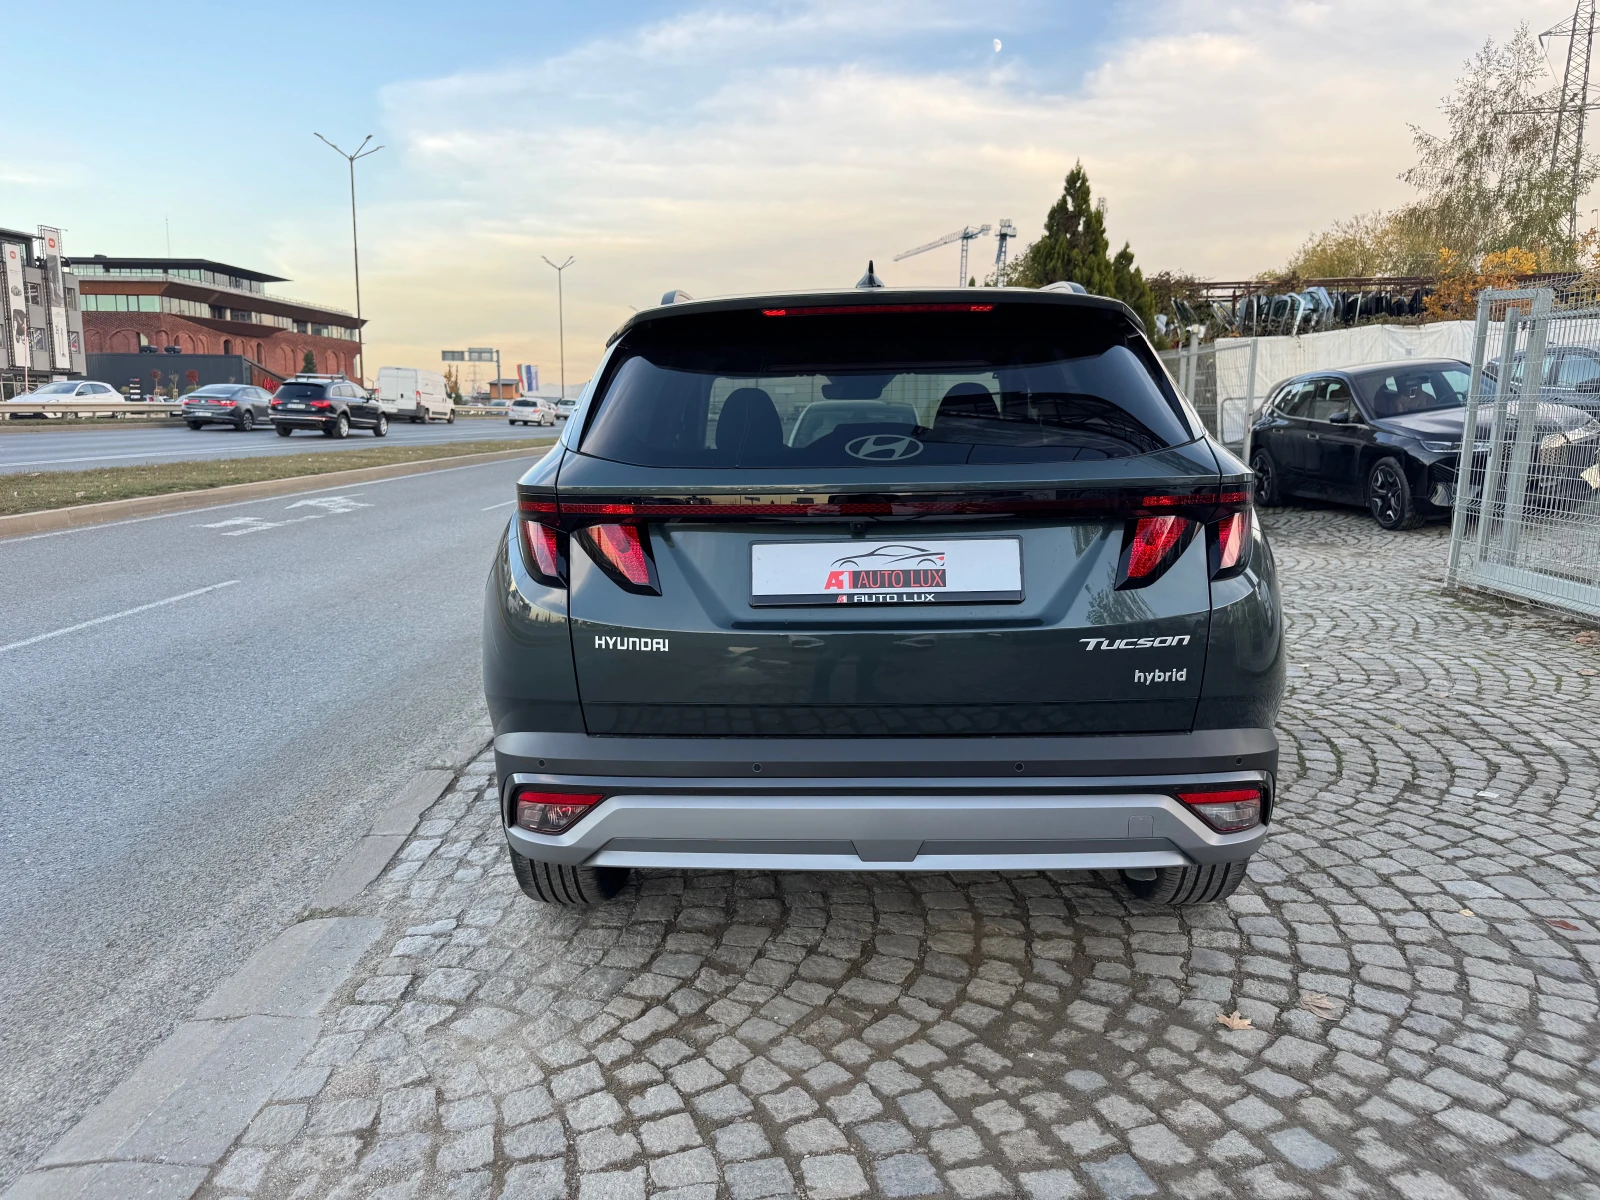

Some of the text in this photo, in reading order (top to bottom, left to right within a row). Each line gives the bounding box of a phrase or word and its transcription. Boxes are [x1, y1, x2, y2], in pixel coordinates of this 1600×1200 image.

[824, 570, 944, 590] A1 AUTO LUX
[903, 594, 936, 602] LUX
[594, 635, 669, 652] HYUNDAI
[1134, 668, 1187, 686] hybrid
